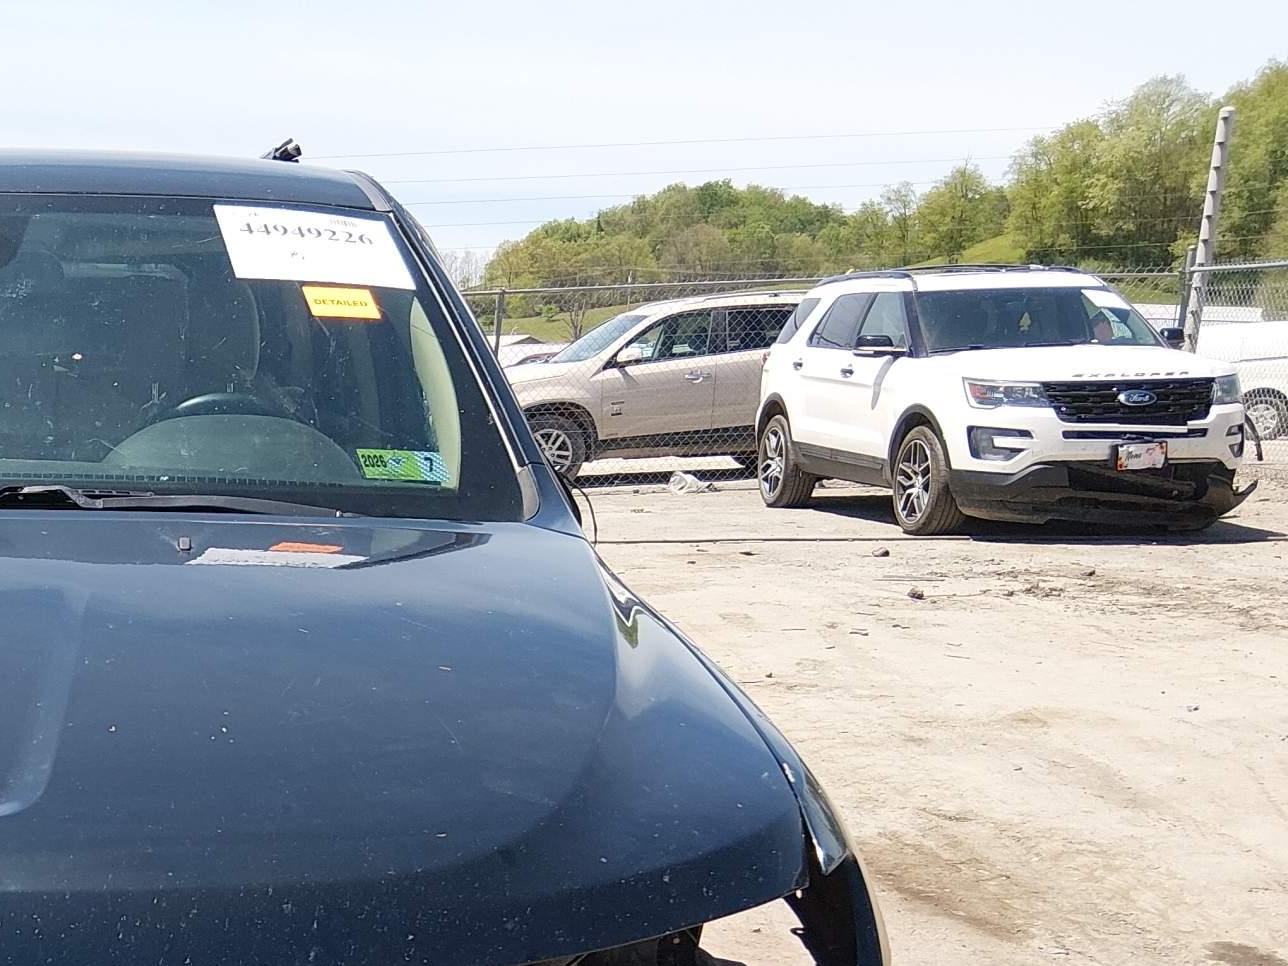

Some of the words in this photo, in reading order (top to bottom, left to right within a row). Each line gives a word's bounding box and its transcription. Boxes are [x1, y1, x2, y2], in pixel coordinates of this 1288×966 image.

[240, 221, 374, 246] 44949226
[313, 298, 369, 308] DETAILED
[361, 454, 388, 469] 2026
[423, 456, 433, 473] 7
